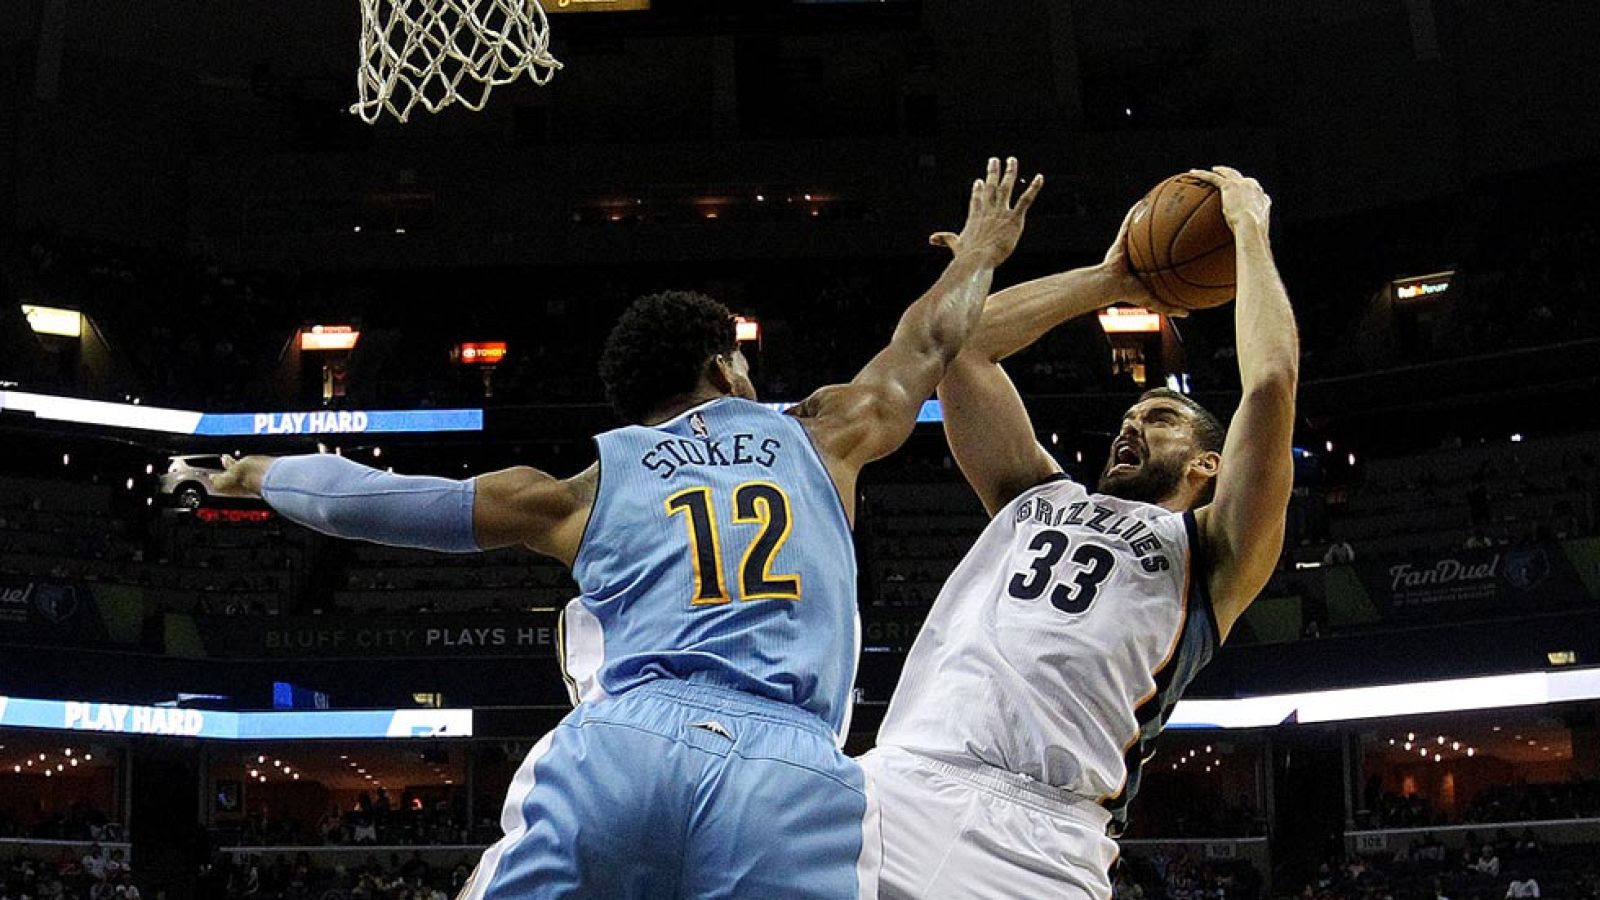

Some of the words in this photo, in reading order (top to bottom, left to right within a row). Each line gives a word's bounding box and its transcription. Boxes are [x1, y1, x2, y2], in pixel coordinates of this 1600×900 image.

[254, 411, 307, 434] PLAY
[309, 410, 369, 433] HARD
[642, 434, 780, 479] STOKES
[664, 480, 801, 605] 12
[1016, 497, 1170, 573] GRIZZLIES
[1008, 530, 1116, 614] 33
[1389, 554, 1500, 593] FanDuel
[357, 629, 416, 647] CITY
[426, 627, 507, 646] PLAYS
[517, 626, 557, 646] HE
[65, 701, 129, 731] PLAY
[132, 706, 202, 736] HARD
